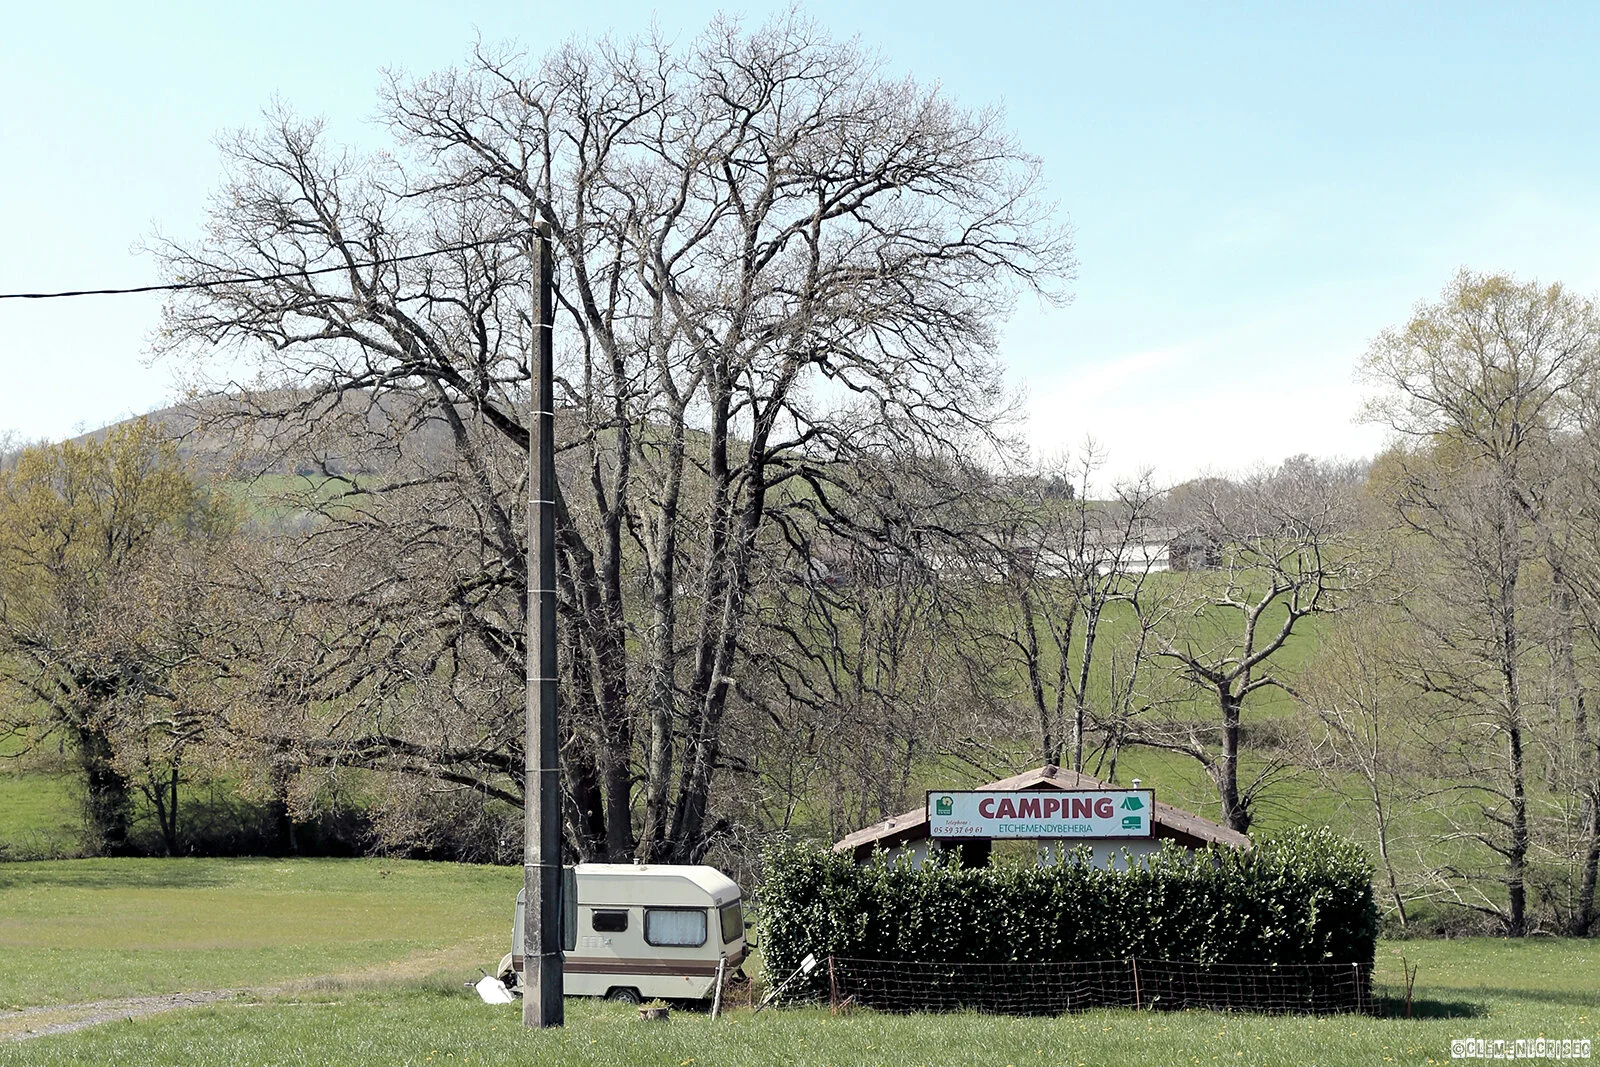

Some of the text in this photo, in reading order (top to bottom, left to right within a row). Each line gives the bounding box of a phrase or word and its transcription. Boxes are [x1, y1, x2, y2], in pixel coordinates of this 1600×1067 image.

[978, 798, 1114, 819] CAMPING
[933, 826, 943, 834] 05
[944, 826, 954, 834] 59
[954, 826, 964, 834] 37
[974, 826, 983, 834] 61
[999, 824, 1093, 833] ETCHEMENDYBEHERIA
